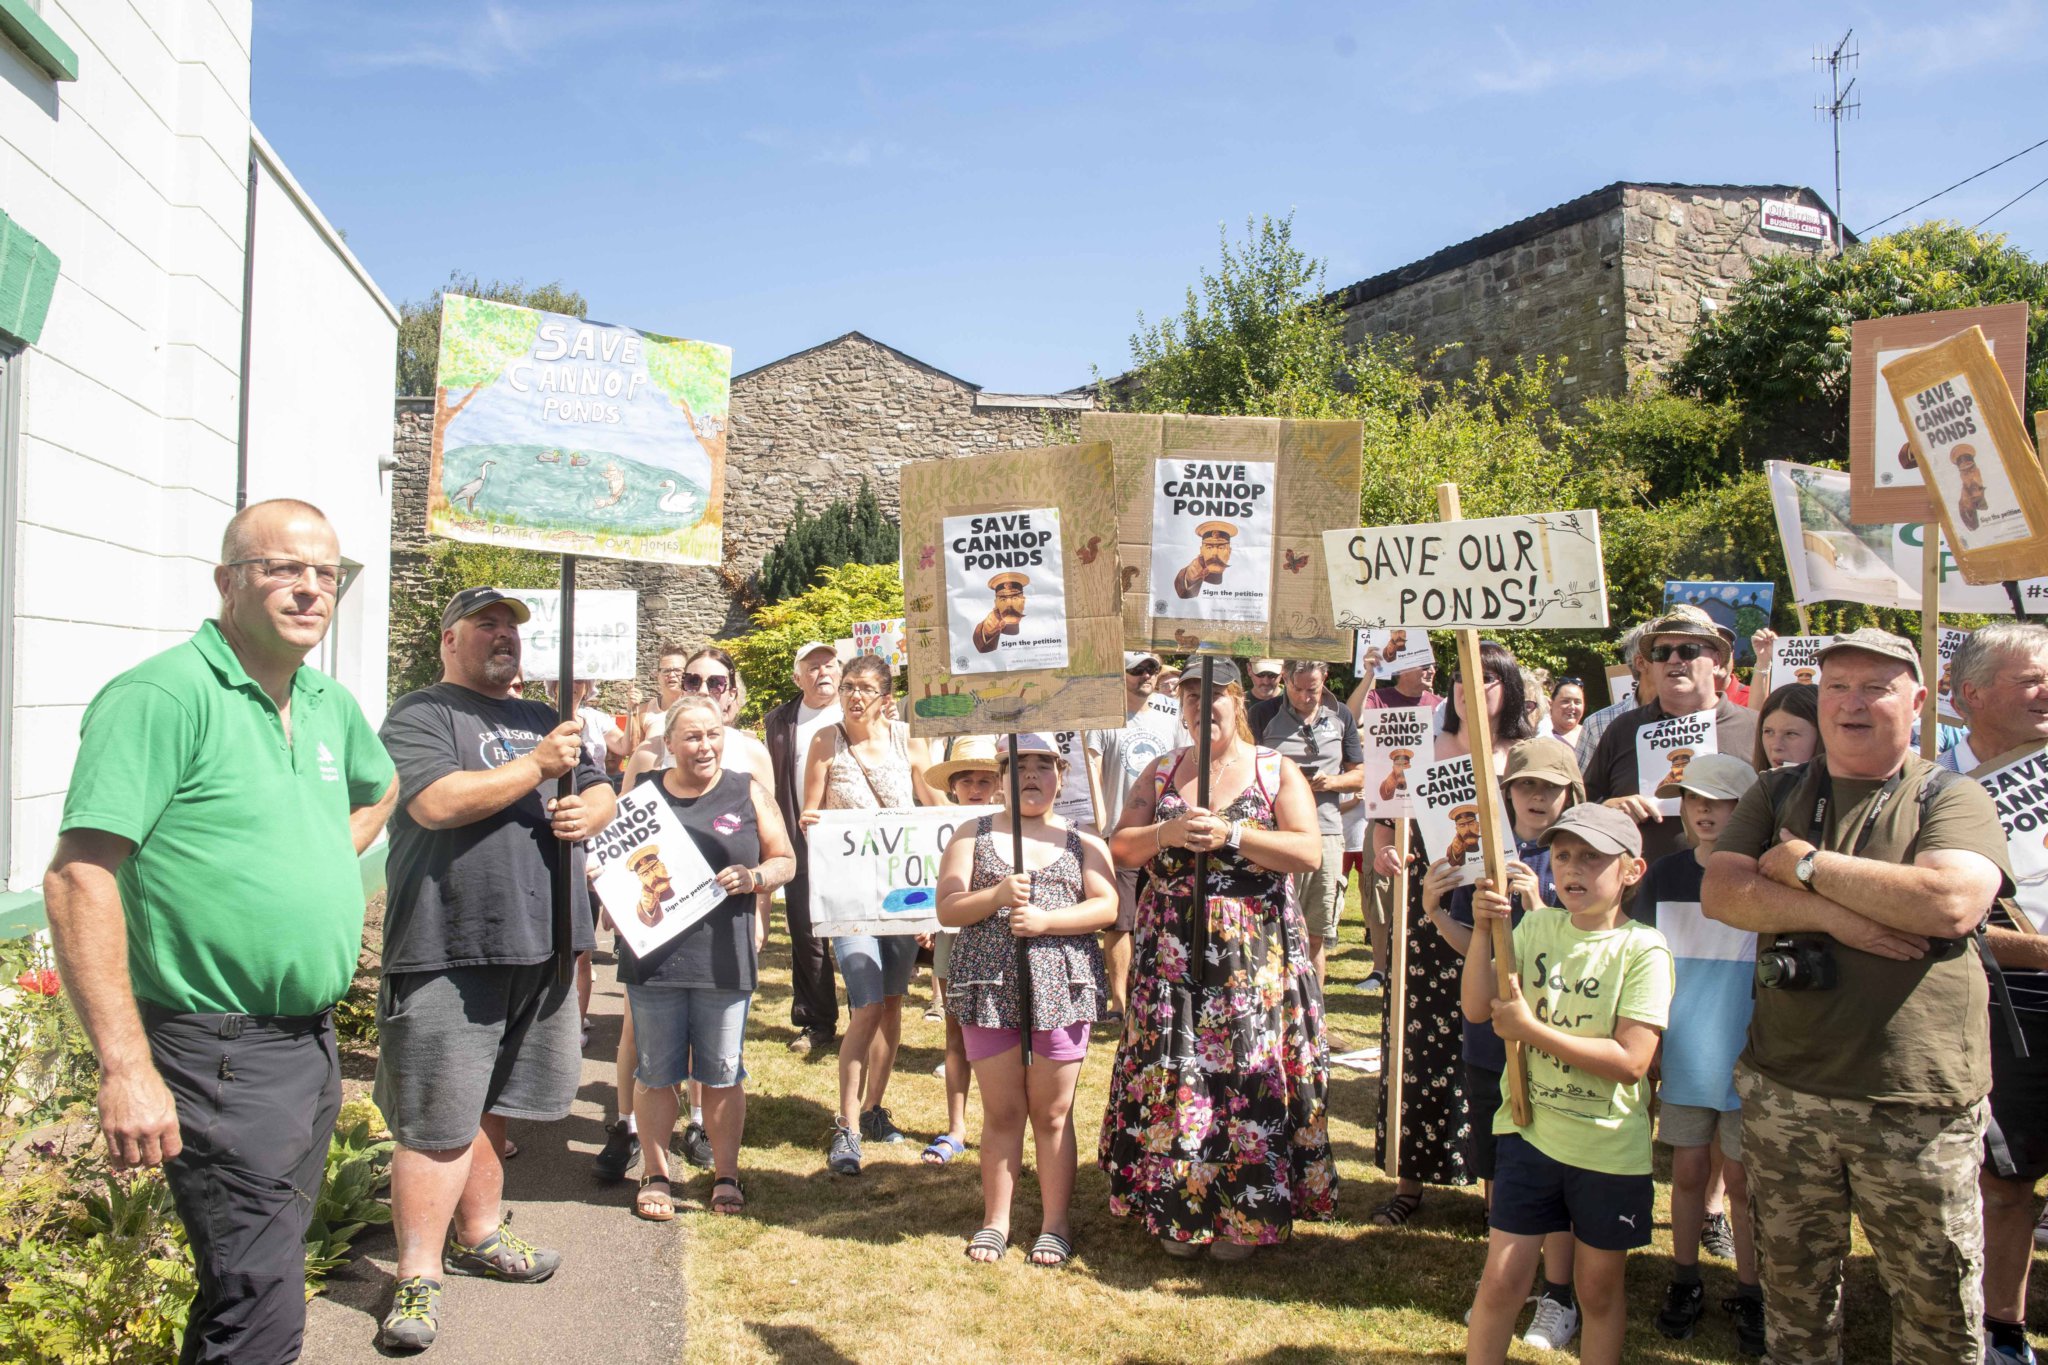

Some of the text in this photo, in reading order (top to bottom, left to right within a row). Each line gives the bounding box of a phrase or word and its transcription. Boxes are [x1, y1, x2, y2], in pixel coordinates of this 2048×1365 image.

[1769, 218, 1824, 234] BUSINESS CENTRE
[534, 322, 641, 365] SAVE
[509, 361, 648, 401] CANNOP
[1916, 380, 1956, 411] SAVE
[542, 397, 622, 424] PONDS
[1915, 395, 1974, 432] CANNOP
[1926, 416, 1977, 448] PONDS
[1183, 463, 1246, 481] SAVE
[1163, 481, 1265, 500] CANNOP
[1173, 500, 1254, 518] PONDS
[1991, 512, 2001, 521] the
[2001, 508, 2022, 519] petition
[970, 514, 1031, 535] SAVE
[492, 525, 679, 552] PROTECT OUR HOMES
[952, 531, 1052, 554] CANNOP
[964, 550, 1043, 571] PONDS
[1348, 530, 1538, 585] SAVE OUR
[1202, 589, 1219, 598] Sign
[1220, 589, 1233, 597] the
[1234, 590, 1264, 599] petition
[1399, 575, 1538, 625] PONDS!
[854, 620, 895, 636] HANDS
[856, 635, 880, 648] OFF
[1001, 640, 1018, 649] Sign
[1032, 637, 1062, 647] petition
[1788, 639, 1820, 649] SAVE
[1777, 648, 1821, 658] CANN
[1783, 658, 1821, 667] POND
[1380, 712, 1416, 723] SAVE
[1656, 715, 1697, 729] SAVE
[1369, 722, 1428, 736] CANNOP
[1643, 722, 1711, 740] CANNOP
[1375, 735, 1423, 747] PONDS
[1650, 734, 1704, 750] PONDS
[1426, 758, 1473, 781] SAVE
[1416, 772, 1476, 797] CANNO
[1427, 788, 1477, 809] POND
[1814, 798, 1827, 823] Canon
[584, 800, 658, 854] CANNOP
[596, 818, 662, 866] PONDS
[843, 826, 918, 857] SAVE
[887, 855, 939, 887] PON
[664, 877, 713, 913] Sign the petition
[1532, 952, 1601, 998] Save
[1535, 996, 1593, 1028] Our
